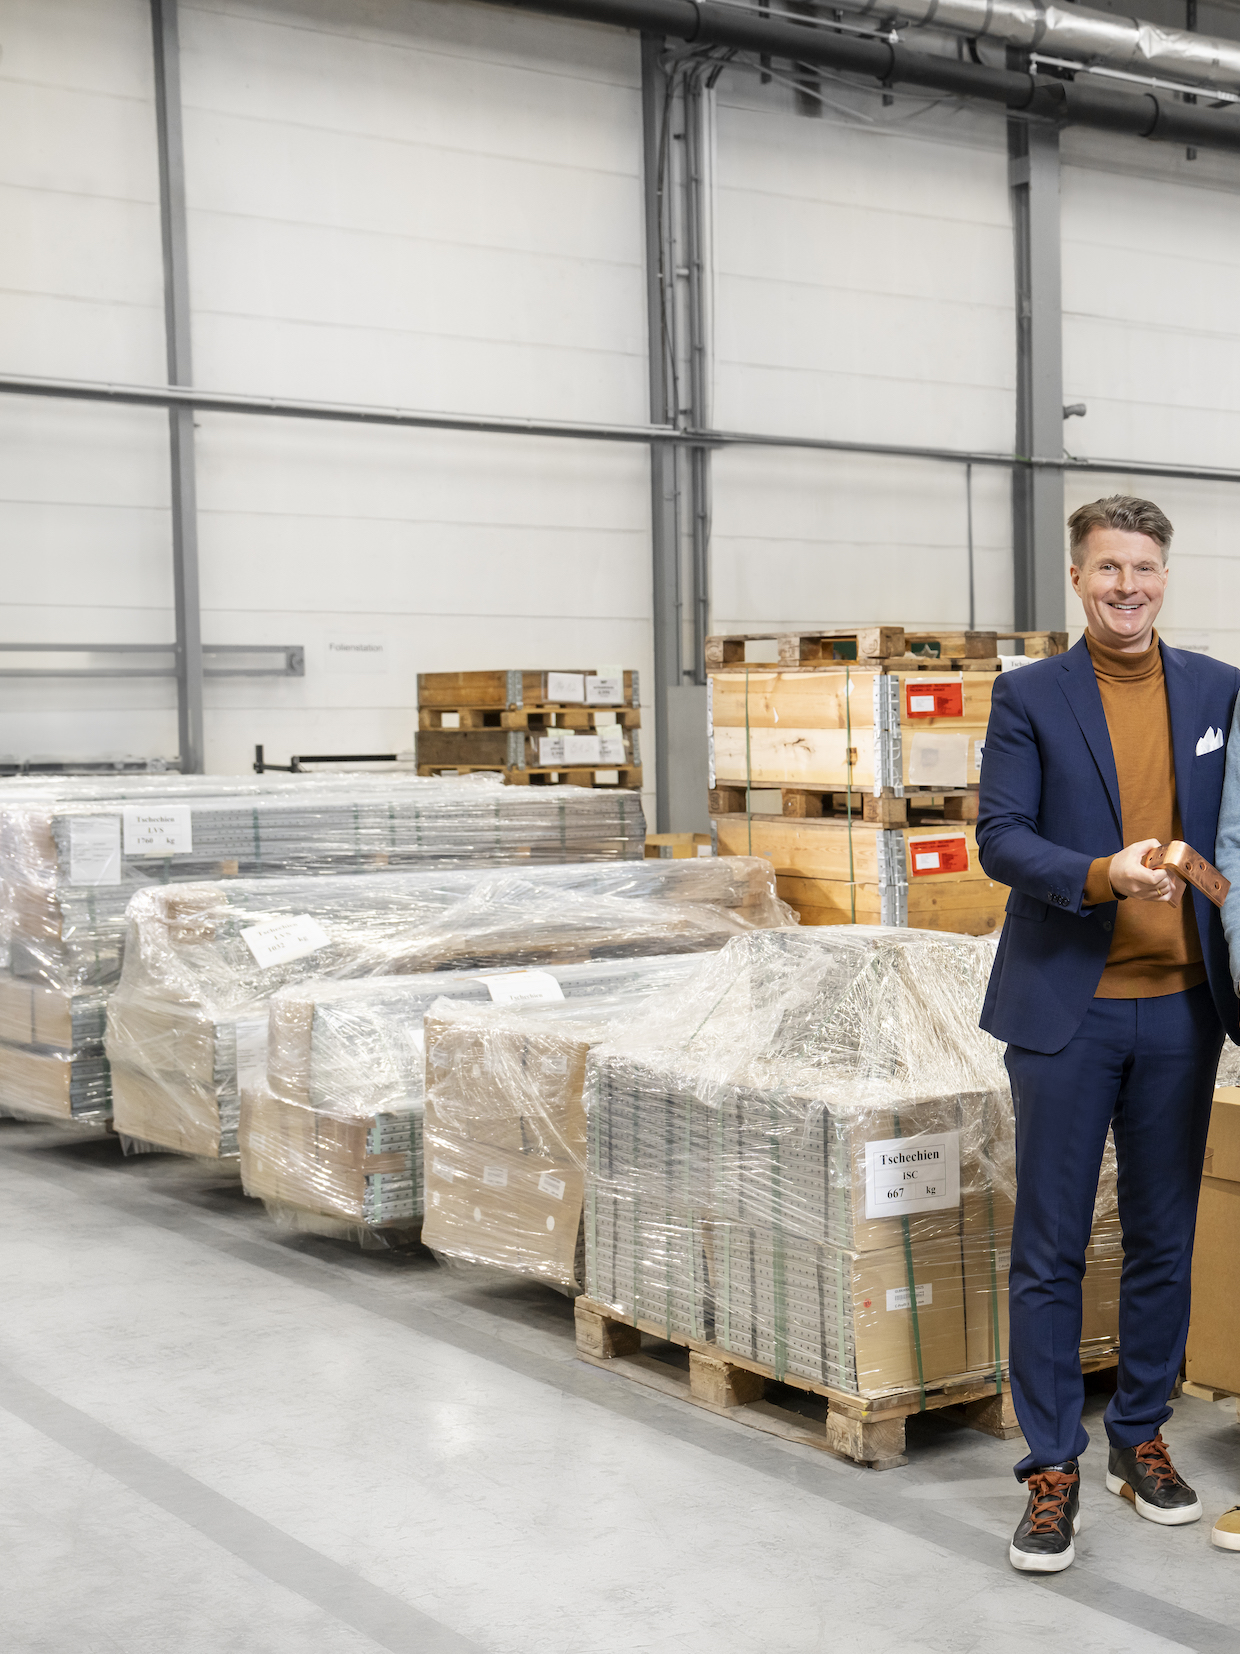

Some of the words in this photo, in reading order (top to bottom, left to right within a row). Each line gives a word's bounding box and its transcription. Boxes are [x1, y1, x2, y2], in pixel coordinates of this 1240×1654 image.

[329, 642, 384, 652] Folienstation
[137, 837, 154, 845] 1760
[166, 837, 176, 846] kg
[880, 1150, 939, 1165] Tschechien
[902, 1170, 919, 1180] ISC
[887, 1187, 905, 1199] 667
[926, 1185, 937, 1195] kg
